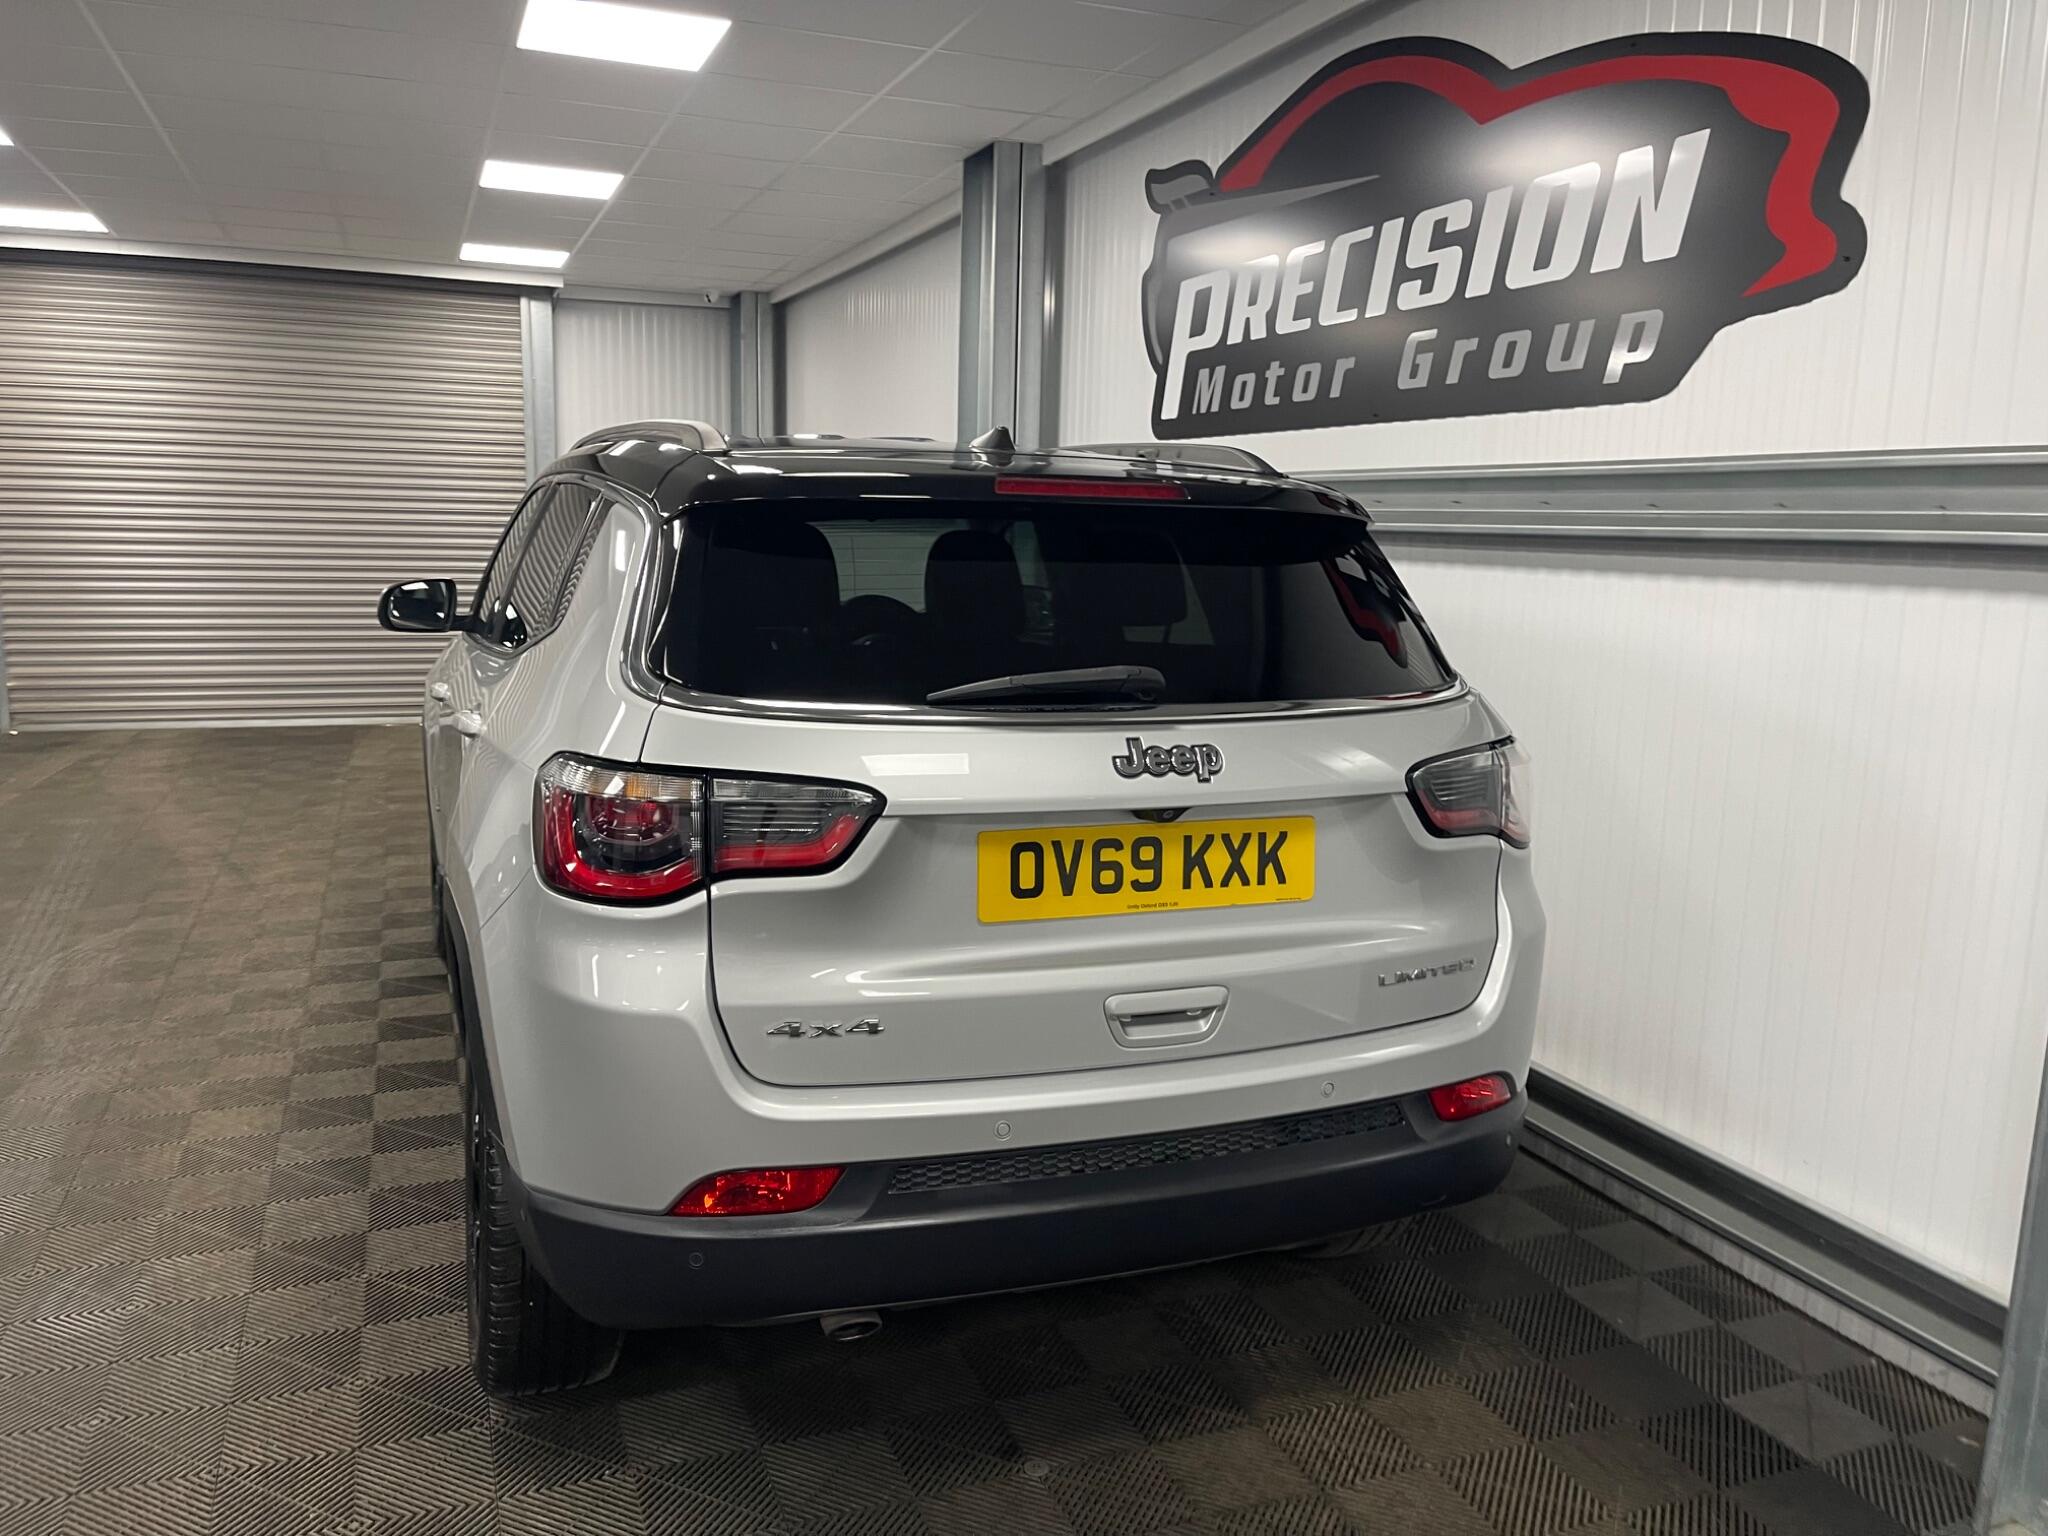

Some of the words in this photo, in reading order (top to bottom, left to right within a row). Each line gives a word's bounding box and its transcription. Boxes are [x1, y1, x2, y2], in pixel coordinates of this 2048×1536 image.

[1160, 128, 1711, 420] PRECISION
[1191, 356, 1355, 415] Motor
[1397, 309, 1664, 390] Group
[1112, 737, 1225, 783] Jeep
[1010, 836, 1163, 899] OV69
[1182, 831, 1288, 890] KXK
[1378, 959, 1474, 987] LIMITED
